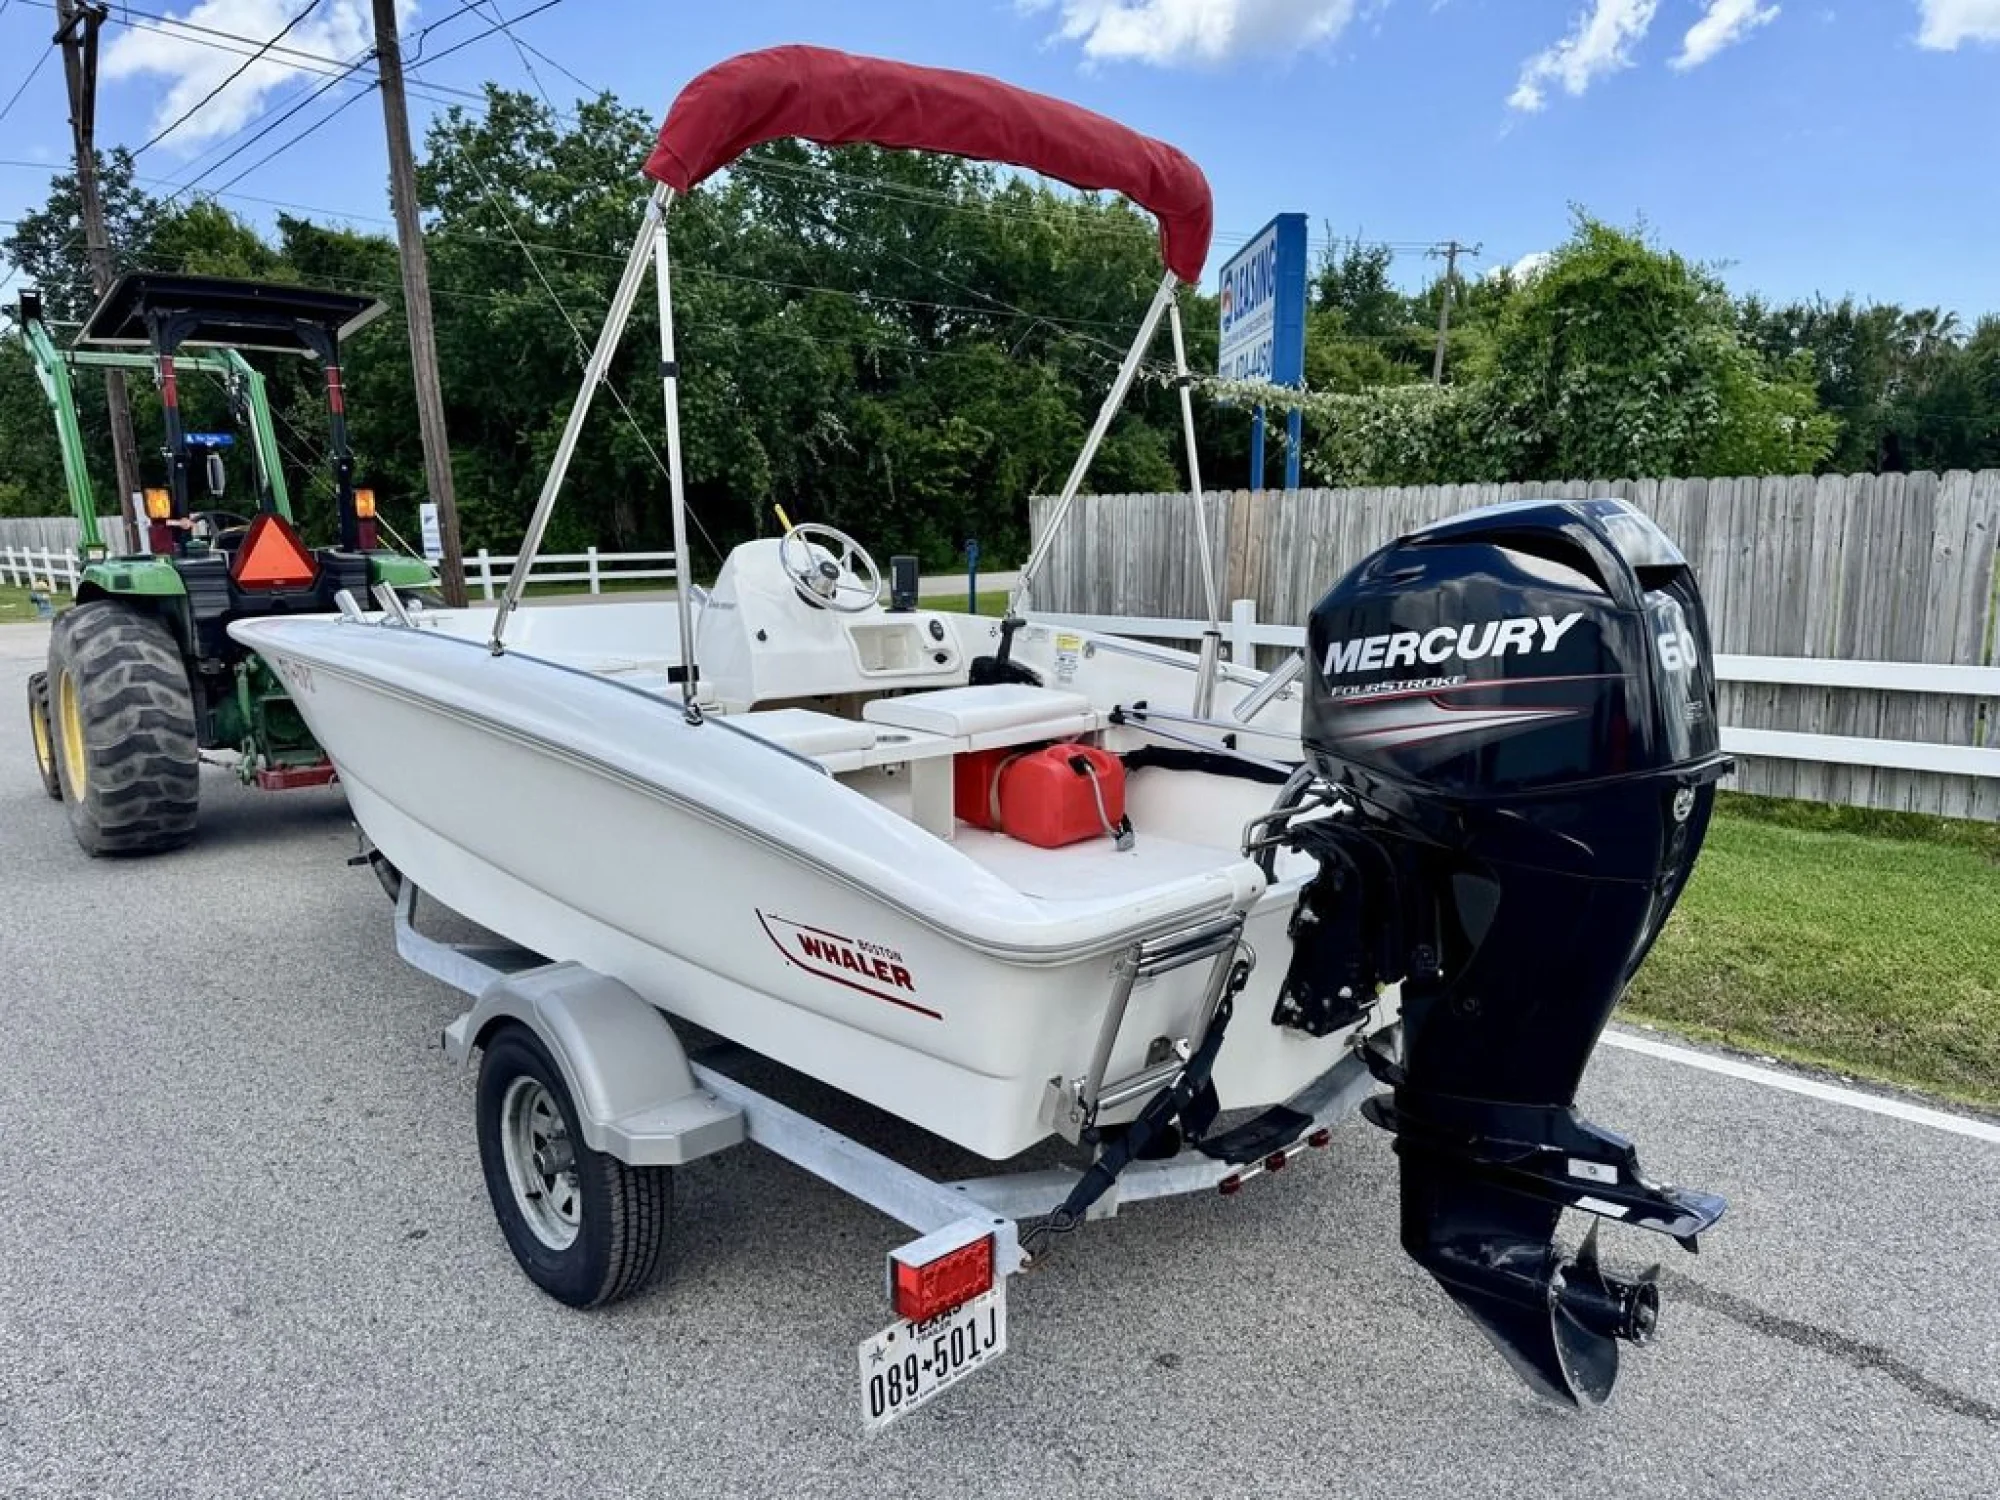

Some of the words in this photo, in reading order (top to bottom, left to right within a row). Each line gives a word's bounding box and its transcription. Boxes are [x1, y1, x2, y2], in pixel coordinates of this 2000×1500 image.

[1324, 613, 1584, 675] MERCURY
[1657, 629, 1698, 671] 60
[1331, 675, 1467, 697] FOURSTROKE
[797, 933, 916, 992] WHALER
[857, 939, 903, 963] BOSTON
